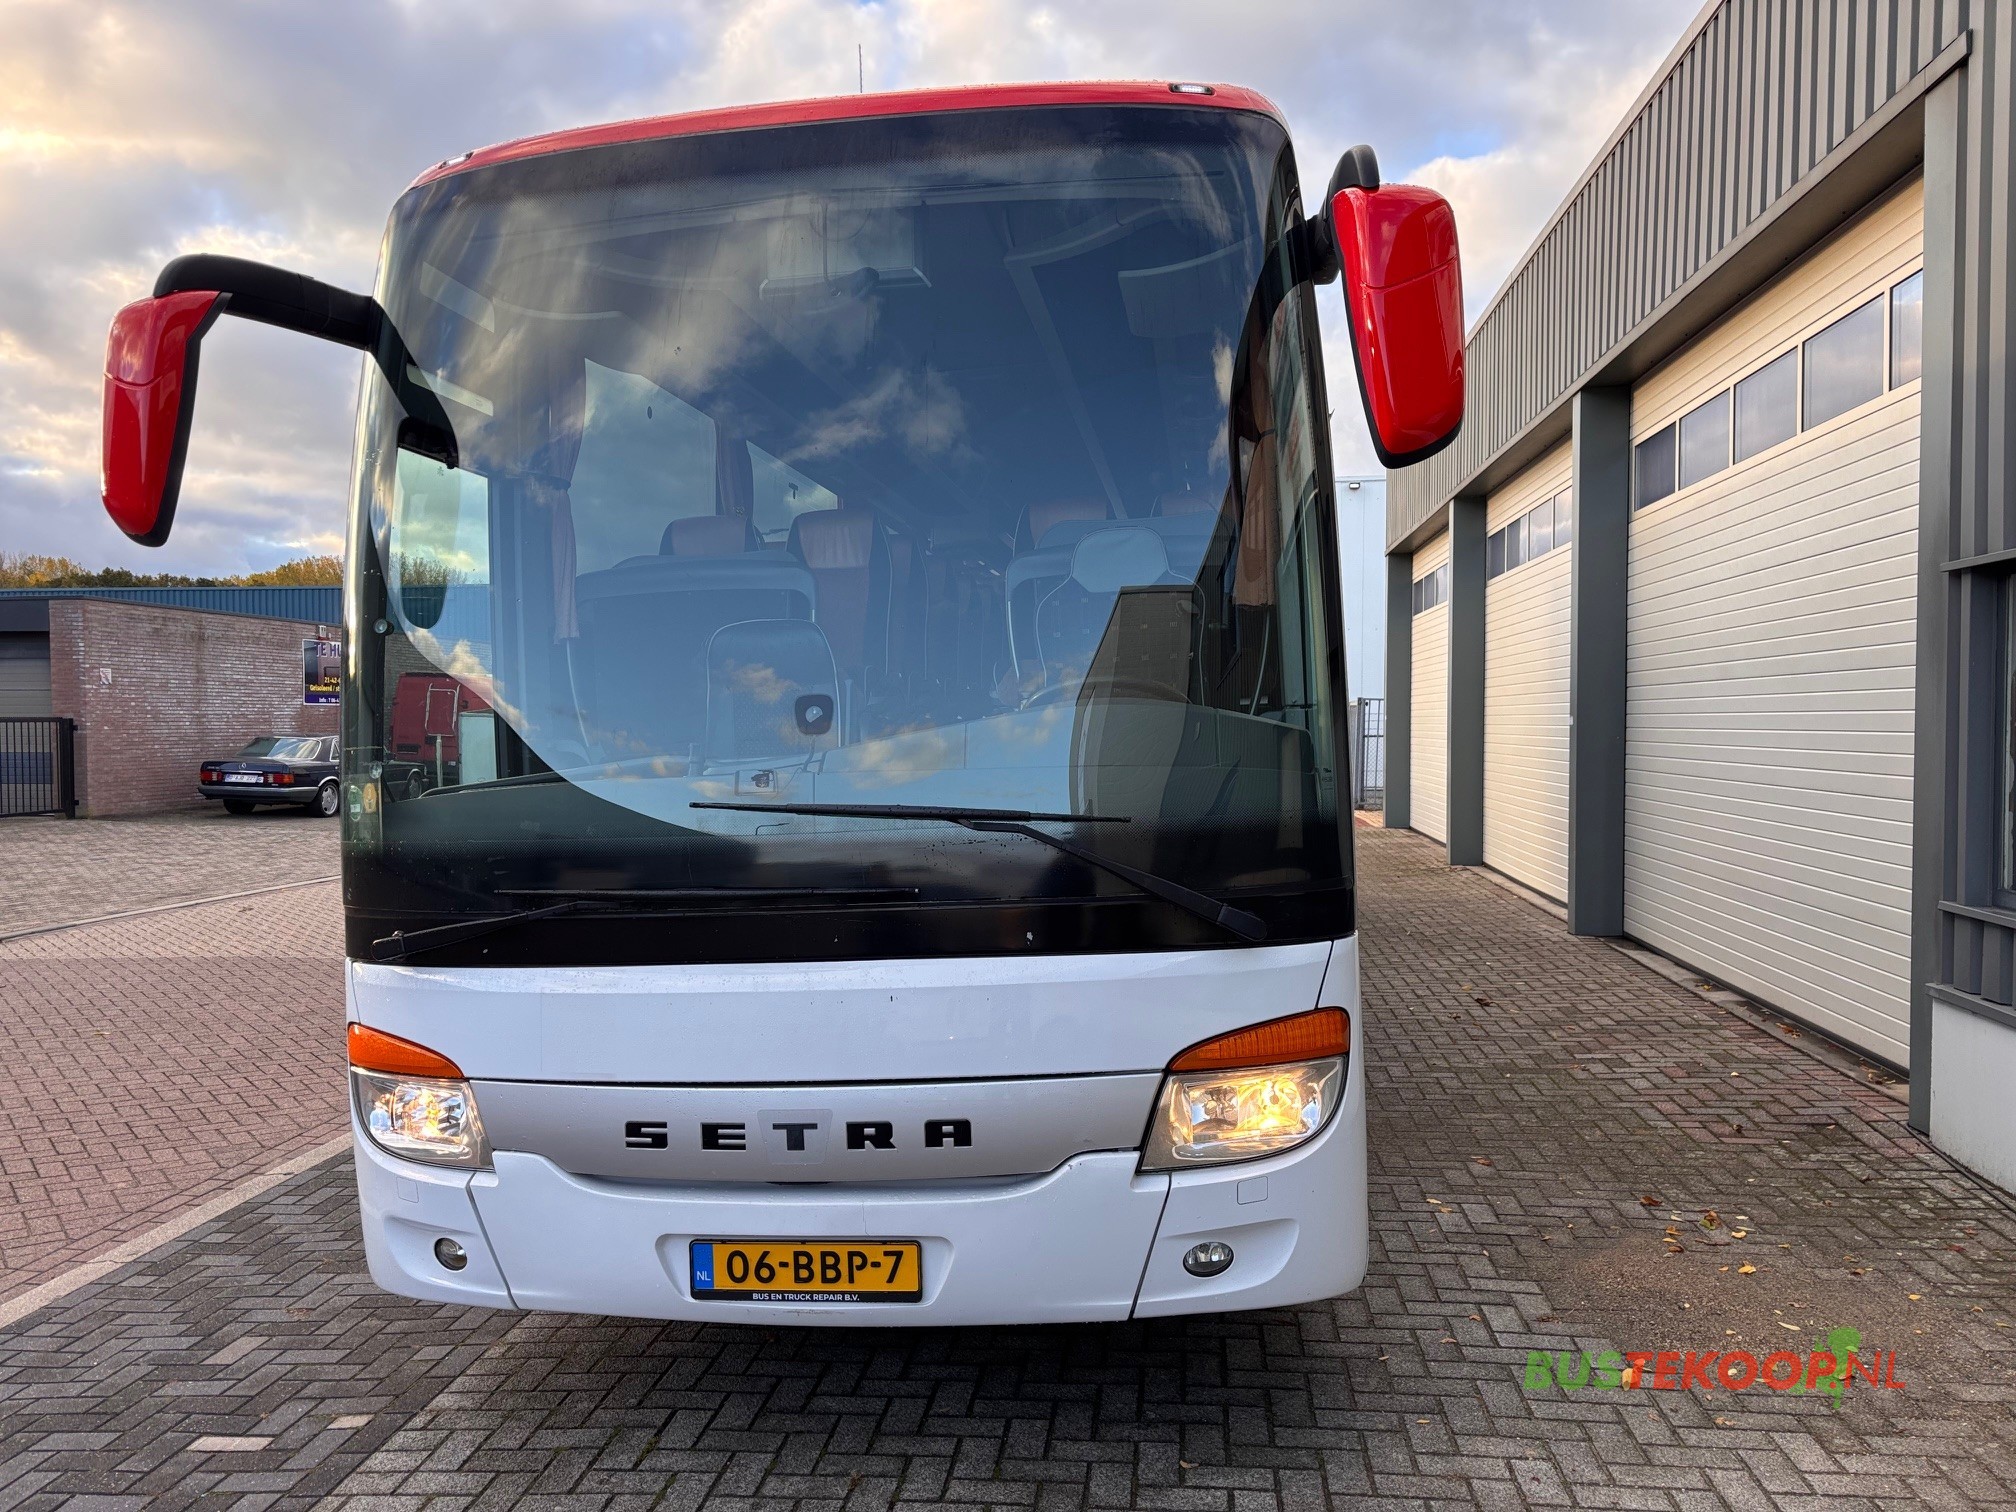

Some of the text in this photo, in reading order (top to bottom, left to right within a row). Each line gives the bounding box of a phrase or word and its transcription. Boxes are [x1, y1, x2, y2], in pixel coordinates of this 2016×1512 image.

[315, 642, 327, 657] TE
[624, 1118, 974, 1152] SETRA
[726, 1250, 904, 1284] 06-BBP-7
[696, 1270, 711, 1282] NL
[752, 1292, 769, 1300] BUS
[784, 1293, 811, 1301] TRUCK
[813, 1293, 843, 1301] REPAIR
